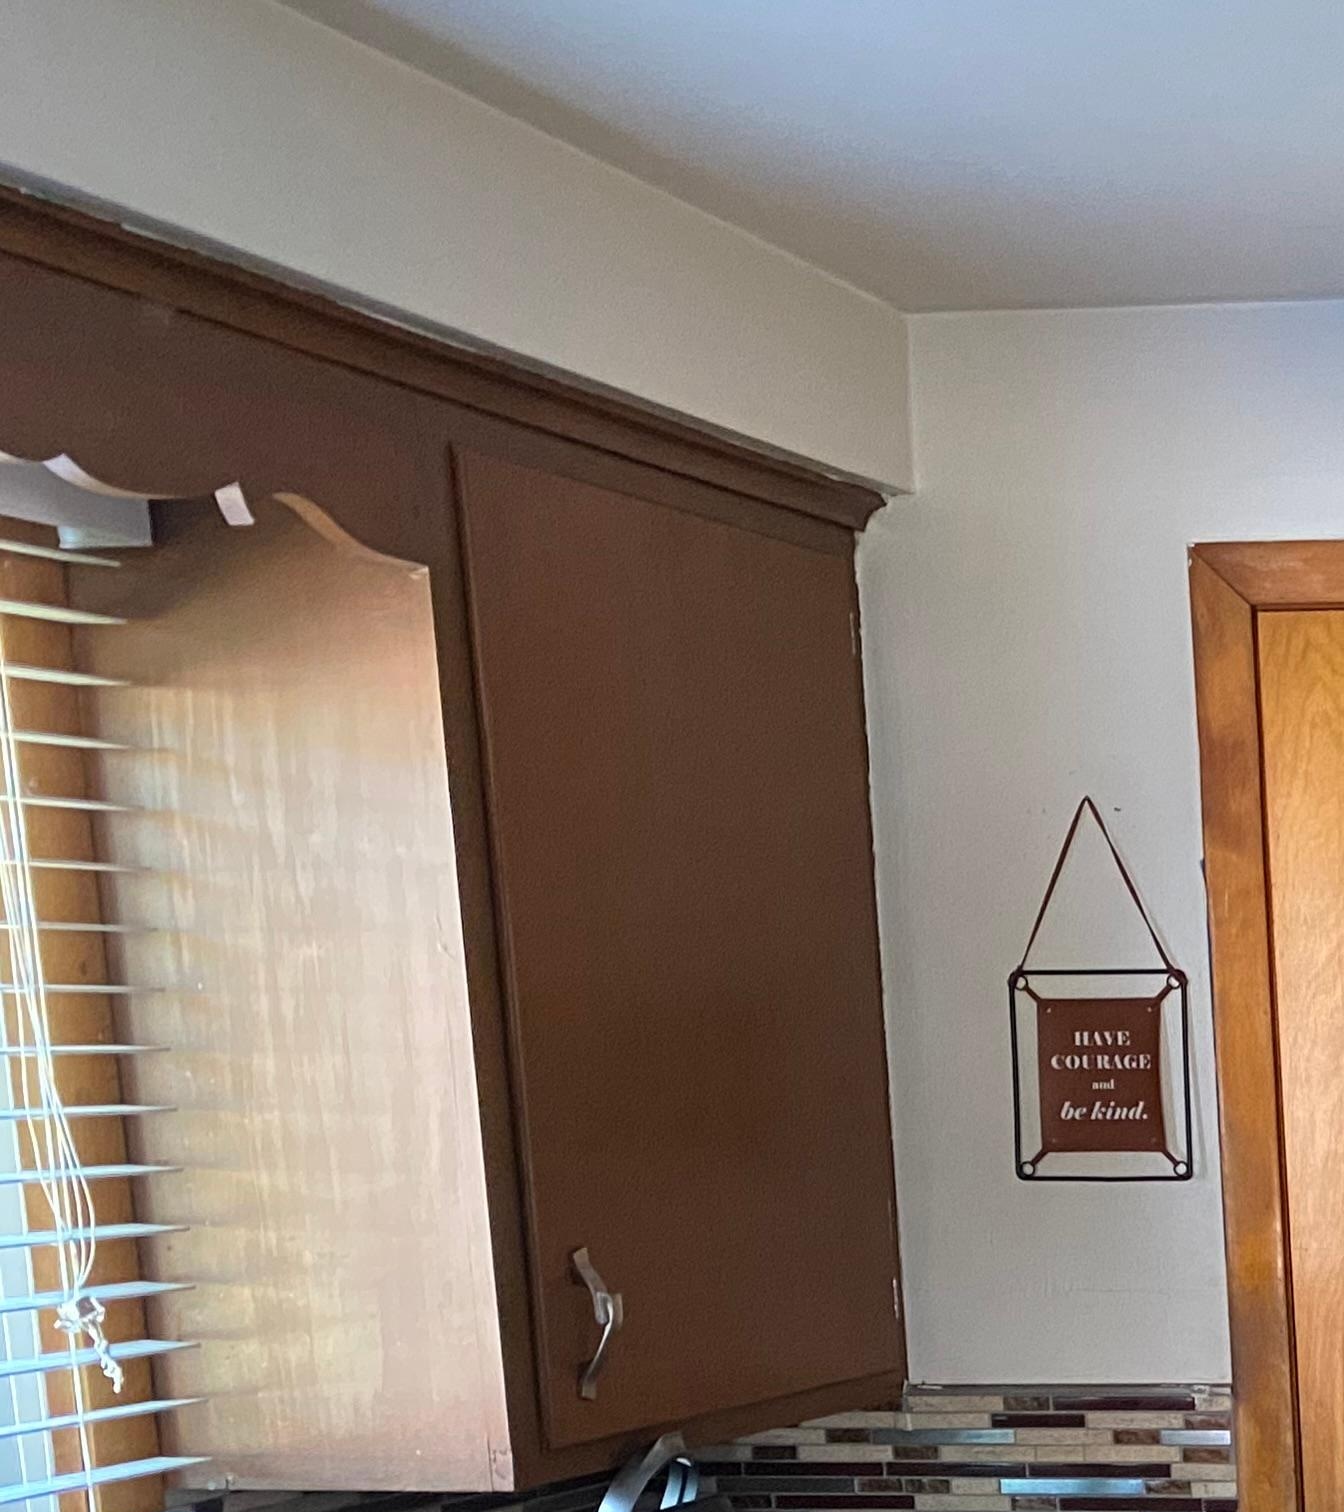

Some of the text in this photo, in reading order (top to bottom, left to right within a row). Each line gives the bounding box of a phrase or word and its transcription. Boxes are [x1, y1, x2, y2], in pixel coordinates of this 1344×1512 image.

[1074, 1031, 1131, 1046] HAVE
[1050, 1054, 1152, 1070] COURAGE
[1092, 1079, 1116, 1090] and
[1060, 1101, 1148, 1120] be kind.
